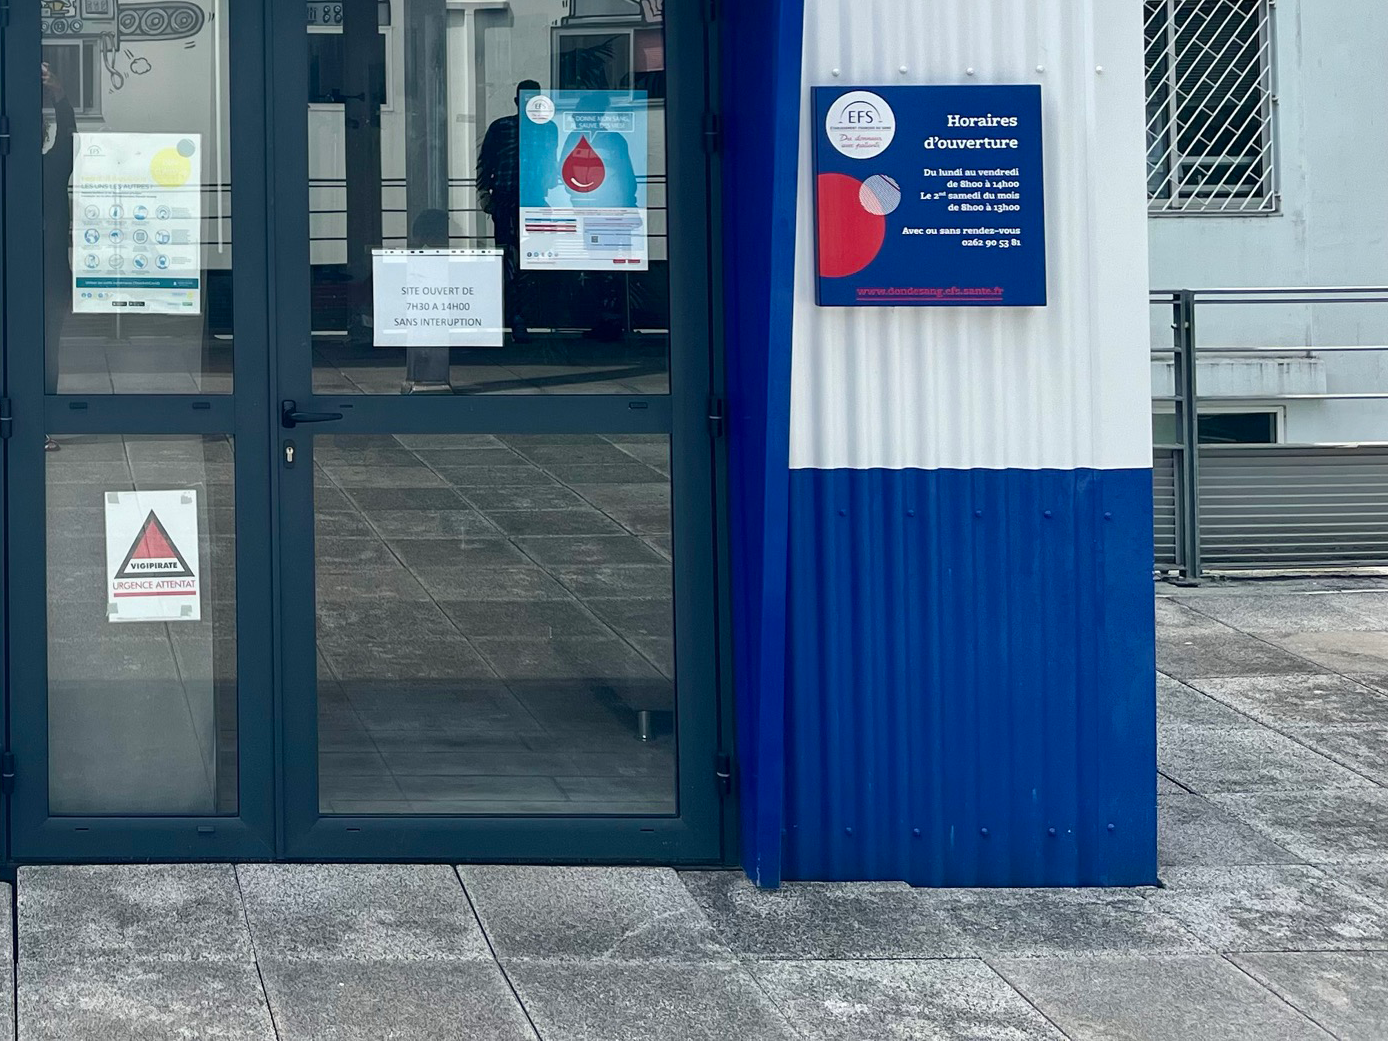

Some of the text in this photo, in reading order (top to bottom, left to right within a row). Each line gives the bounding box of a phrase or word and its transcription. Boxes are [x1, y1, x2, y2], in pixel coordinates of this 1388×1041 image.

[847, 110, 875, 124] EFS
[947, 113, 1018, 128] Horaires
[923, 168, 937, 176] Du
[938, 167, 963, 176] lundi
[978, 167, 1020, 176] vendredi
[947, 179, 1020, 189] de 8h00 à 14h00
[920, 191, 932, 200] Le
[947, 191, 981, 200] samedi
[983, 191, 995, 200] du
[997, 190, 1020, 200] mois
[947, 202, 1021, 213] de 8h00 à 13h00
[902, 226, 924, 235] Avec
[939, 227, 961, 235] sans
[962, 226, 1021, 235] rendez-vous
[961, 238, 1021, 248] 0262 90 53 81
[401, 286, 474, 296] SITE OUVERT DE
[406, 302, 471, 311] 7H30 A 14H00
[394, 317, 482, 327] SANS INTERUPTION
[130, 561, 178, 570] VIGIPIRATE
[113, 579, 196, 590] URGENCE ATTENTAT
